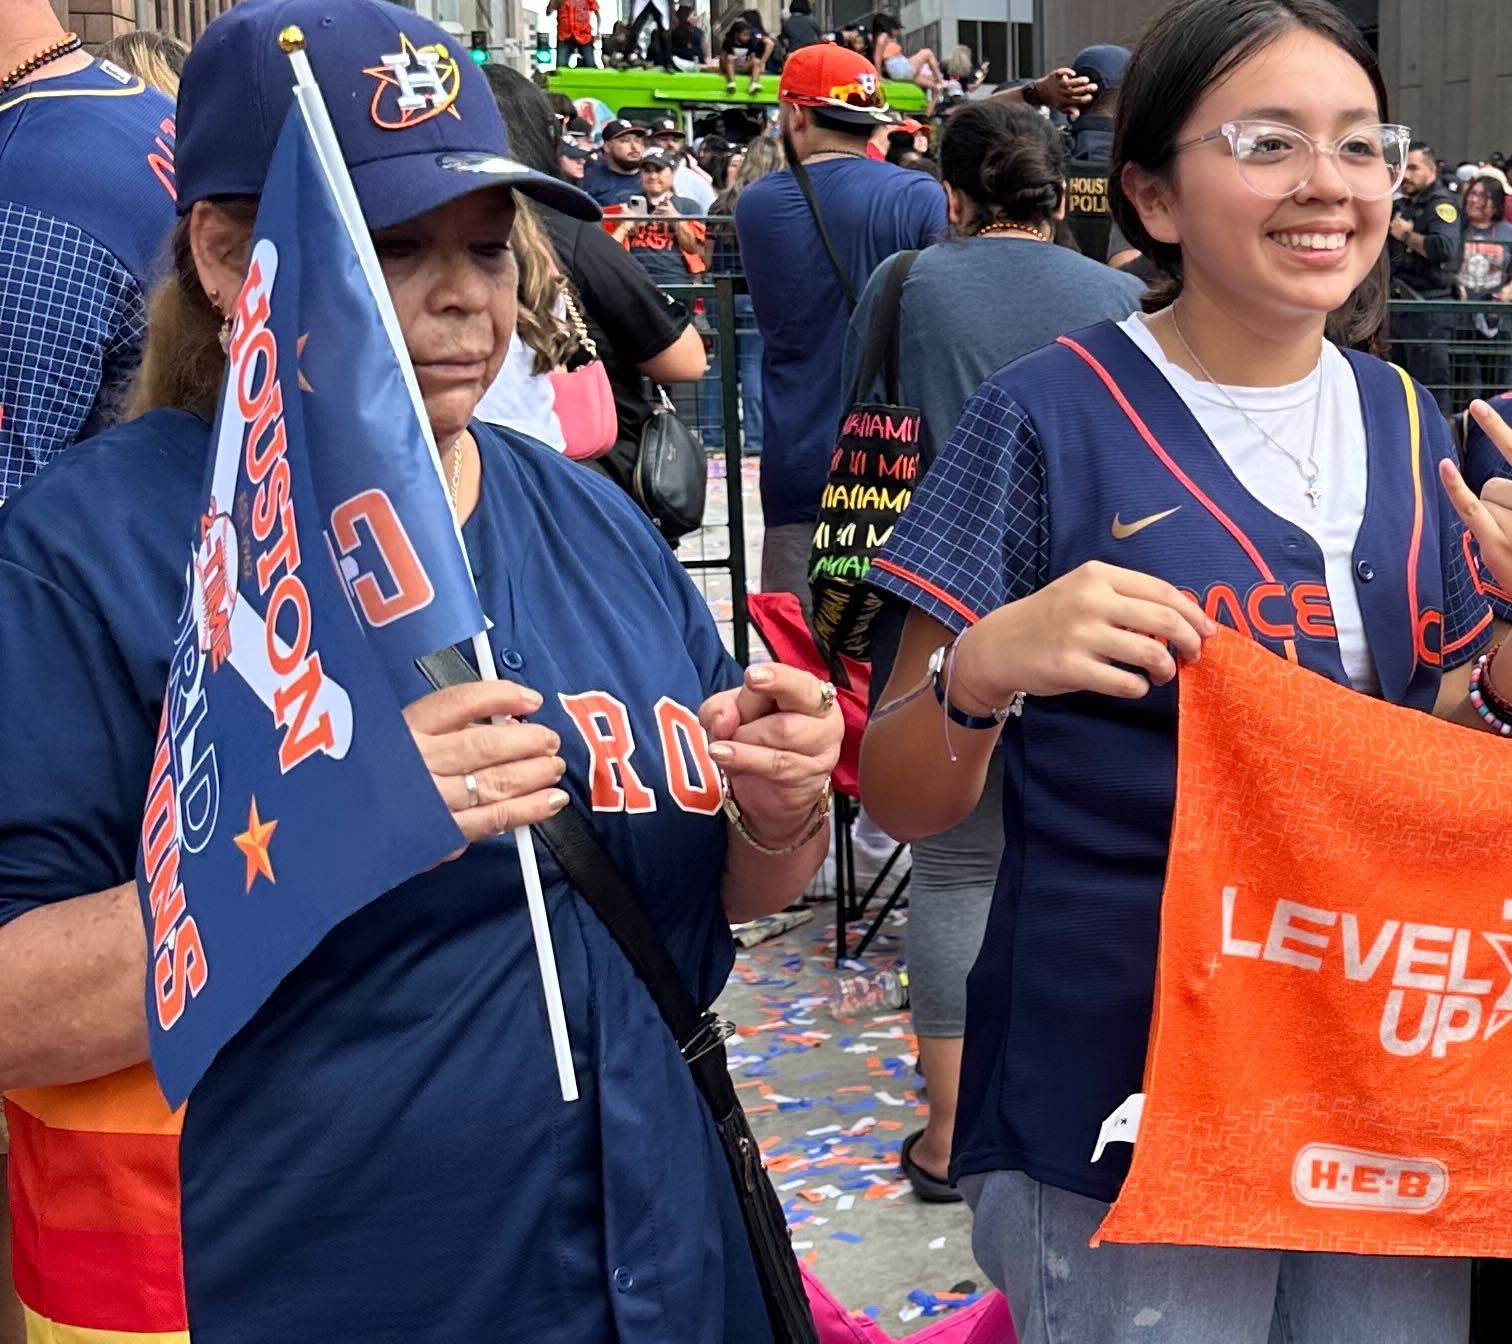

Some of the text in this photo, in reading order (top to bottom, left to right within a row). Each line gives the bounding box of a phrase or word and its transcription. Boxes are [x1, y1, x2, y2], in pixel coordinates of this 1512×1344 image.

[1069, 178, 1108, 194] HOUST
[1069, 195, 1110, 212] POLI
[230, 258, 335, 775] HOUSTON
[1180, 582, 1338, 640] ACE
[171, 556, 220, 854] RLD
[142, 736, 208, 1031] IONS
[1221, 886, 1492, 995] LEVEL
[1380, 988, 1482, 1057] UP
